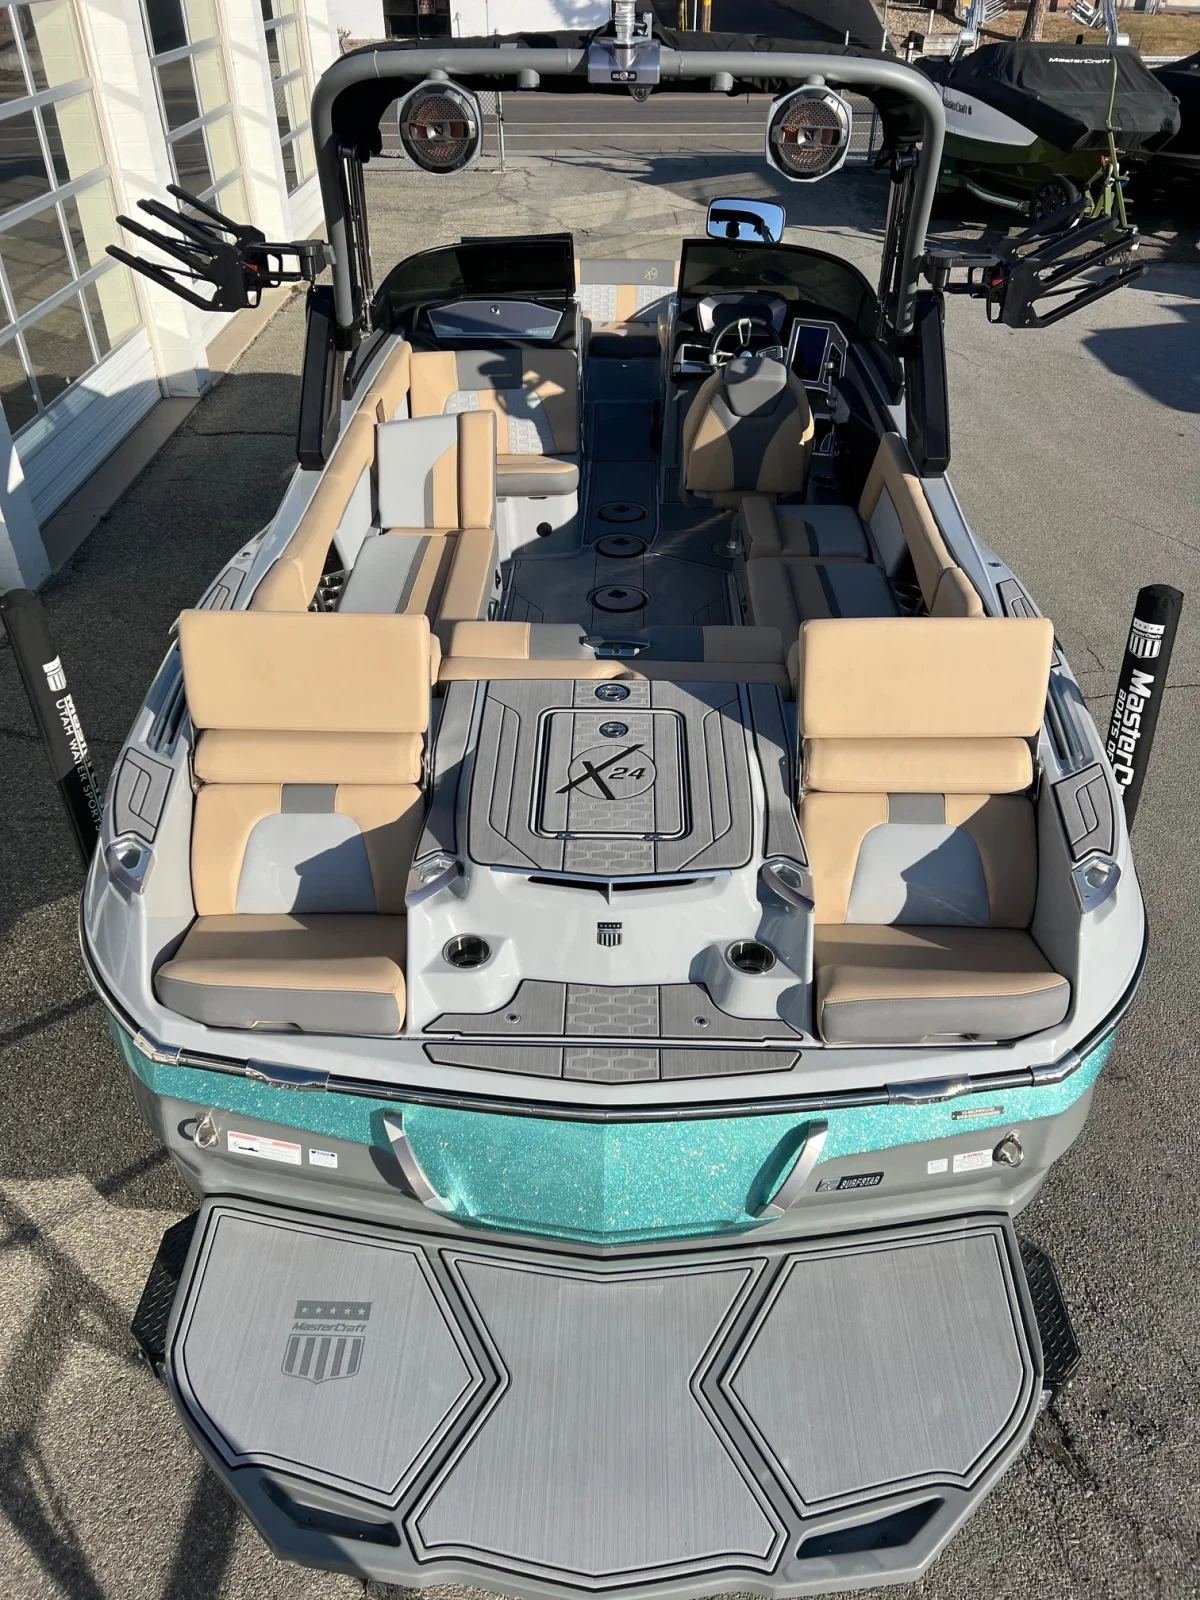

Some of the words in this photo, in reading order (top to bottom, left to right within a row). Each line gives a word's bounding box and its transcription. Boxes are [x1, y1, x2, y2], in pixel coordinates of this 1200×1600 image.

[1111, 688, 1127, 738] BOATS
[56, 698, 75, 736] UTAH
[68, 737, 88, 782] WATER
[840, 1175, 880, 1189] SURFSTAR
[292, 1322, 367, 1332] MasterCraft
